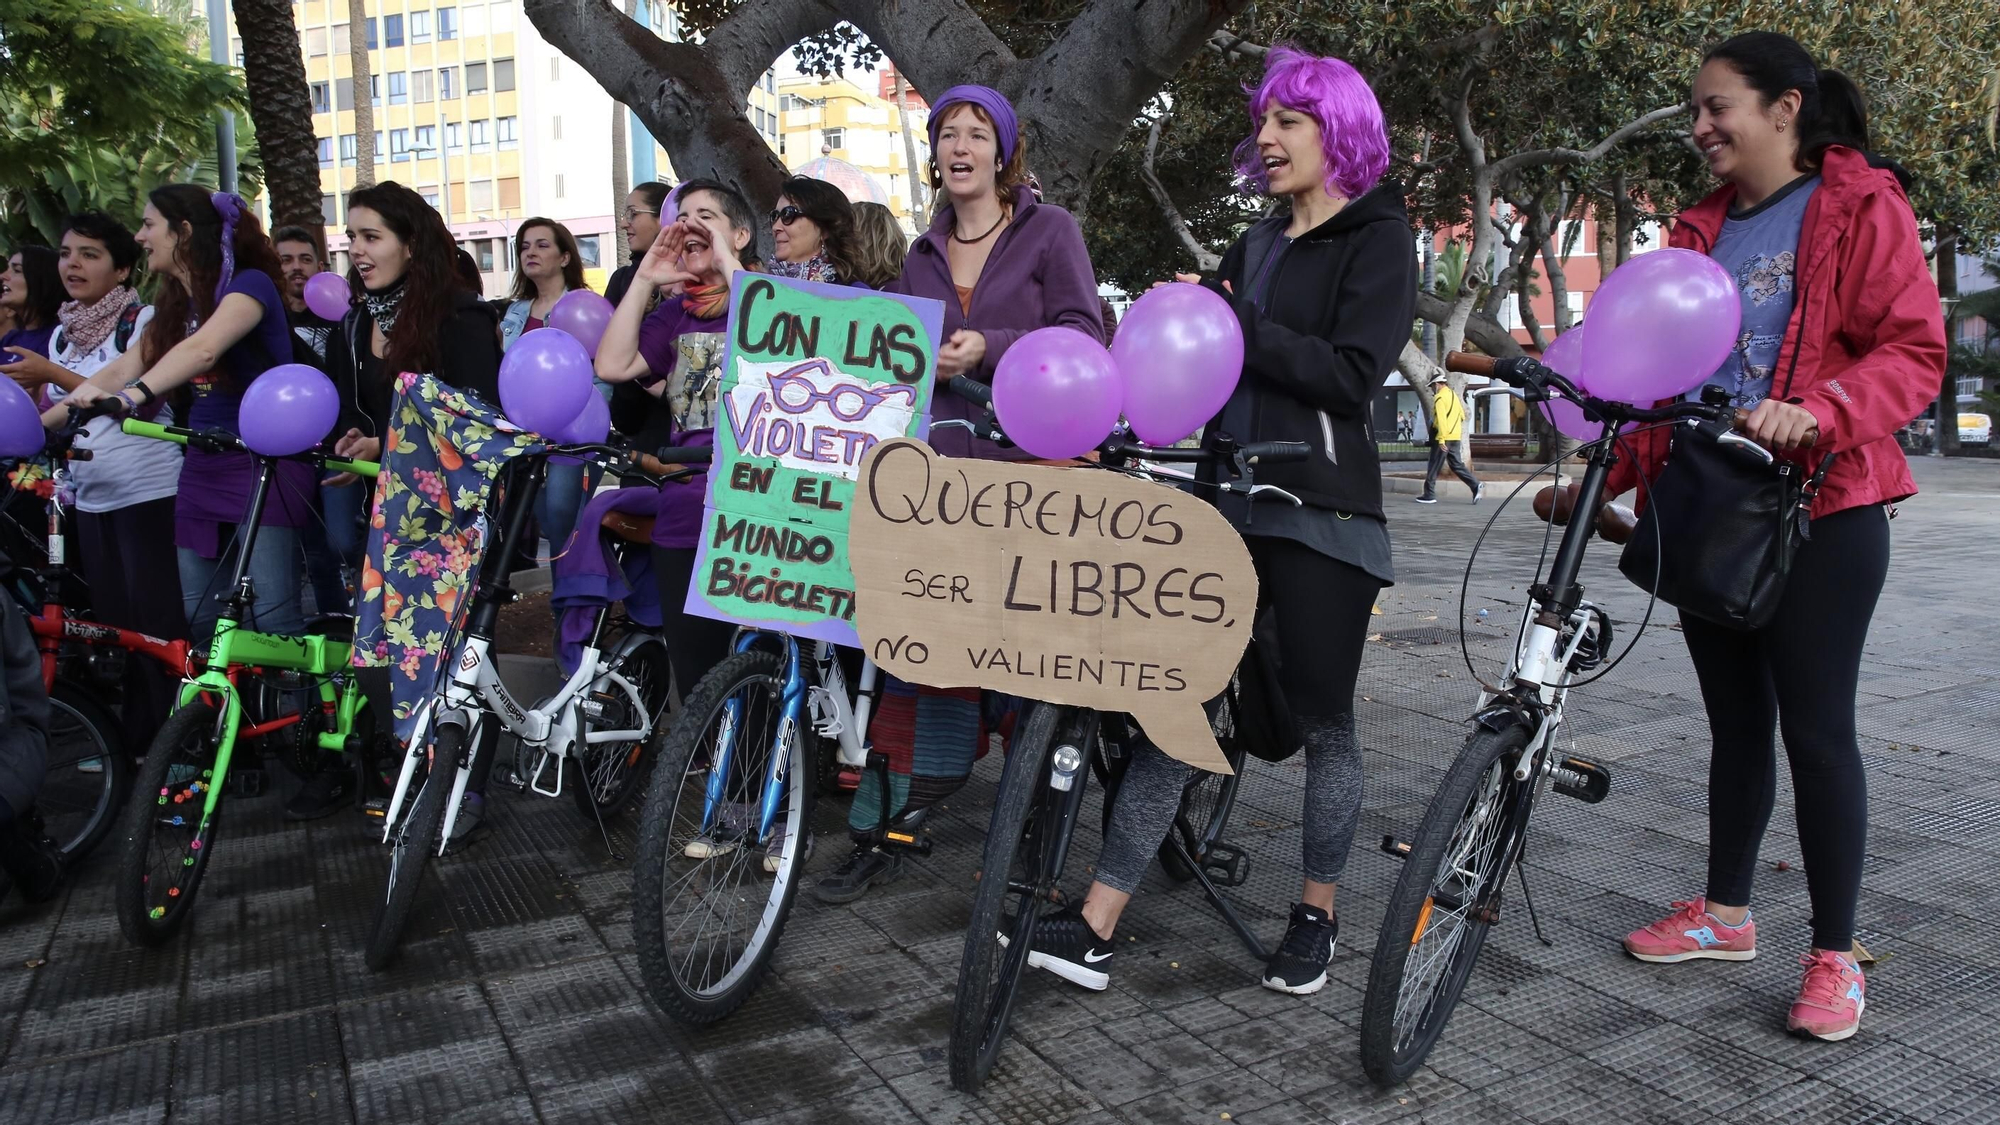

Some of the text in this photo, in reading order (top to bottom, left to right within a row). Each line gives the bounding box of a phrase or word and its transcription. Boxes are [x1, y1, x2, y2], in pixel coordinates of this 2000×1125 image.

[738, 279, 926, 384] CON LAS
[730, 462, 843, 511] EN EL
[868, 442, 1184, 545] QUEREMOS
[713, 514, 835, 565] MUNDO
[901, 555, 1236, 628] SER LIBRES,
[875, 635, 1187, 691] NO VALIENTES
[491, 679, 526, 724] ZAMBRA
